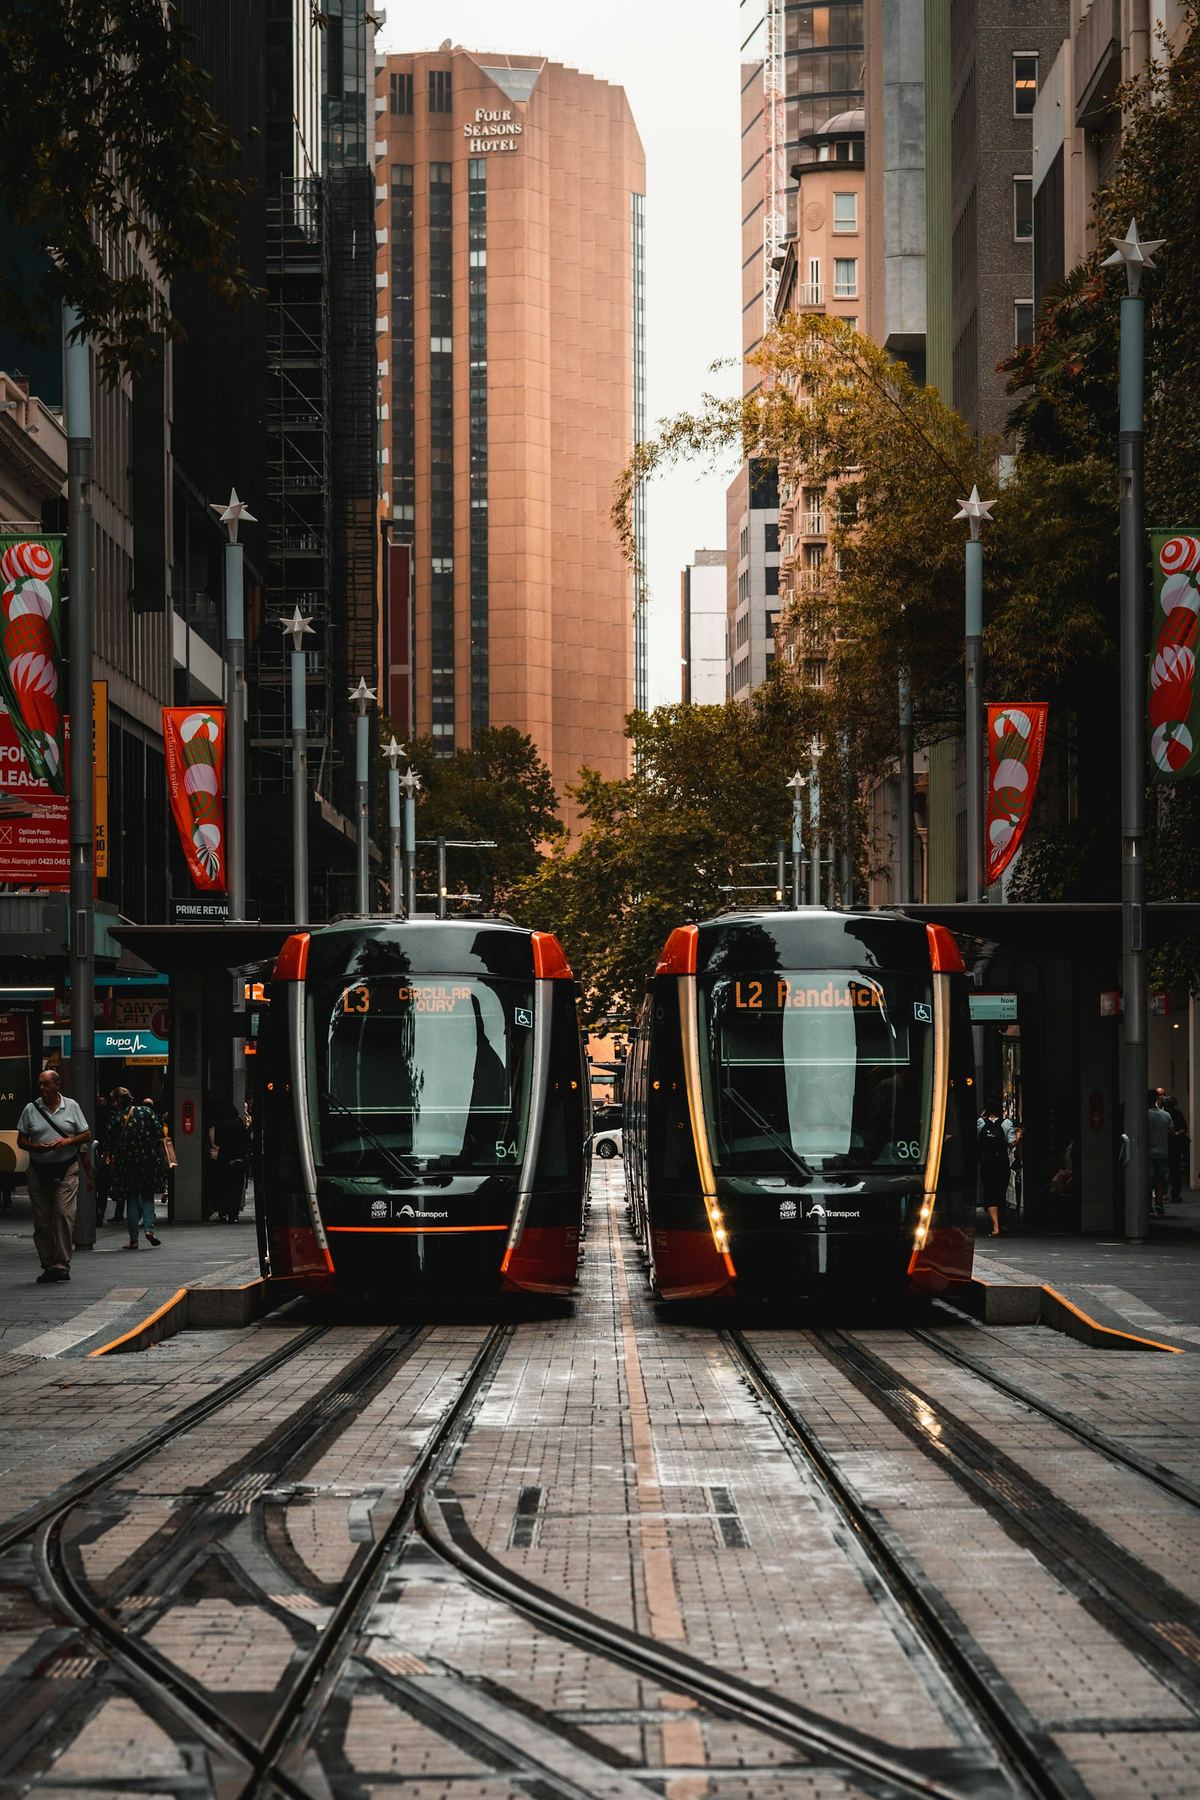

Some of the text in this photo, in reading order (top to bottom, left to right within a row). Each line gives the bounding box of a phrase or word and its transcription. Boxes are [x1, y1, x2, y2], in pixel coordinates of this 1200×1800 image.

[168, 736, 176, 772] christmas
[170, 773, 179, 799] sydney
[18, 828, 50, 837] Option From
[38, 857, 54, 865] 0423
[175, 904, 229, 916] PRIME RETAIL
[343, 986, 370, 1013] L3
[398, 987, 472, 1000] CIRCULAR
[735, 980, 886, 1008] L2 Randwick
[416, 999, 456, 1012] QUAY
[105, 1036, 131, 1047] Bupa
[495, 1140, 519, 1158] 54
[896, 1140, 921, 1159] 36
[371, 1209, 388, 1218] NSW
[414, 1209, 449, 1219] Transport
[779, 1209, 797, 1218] NSW
[825, 1209, 861, 1219] Transport
